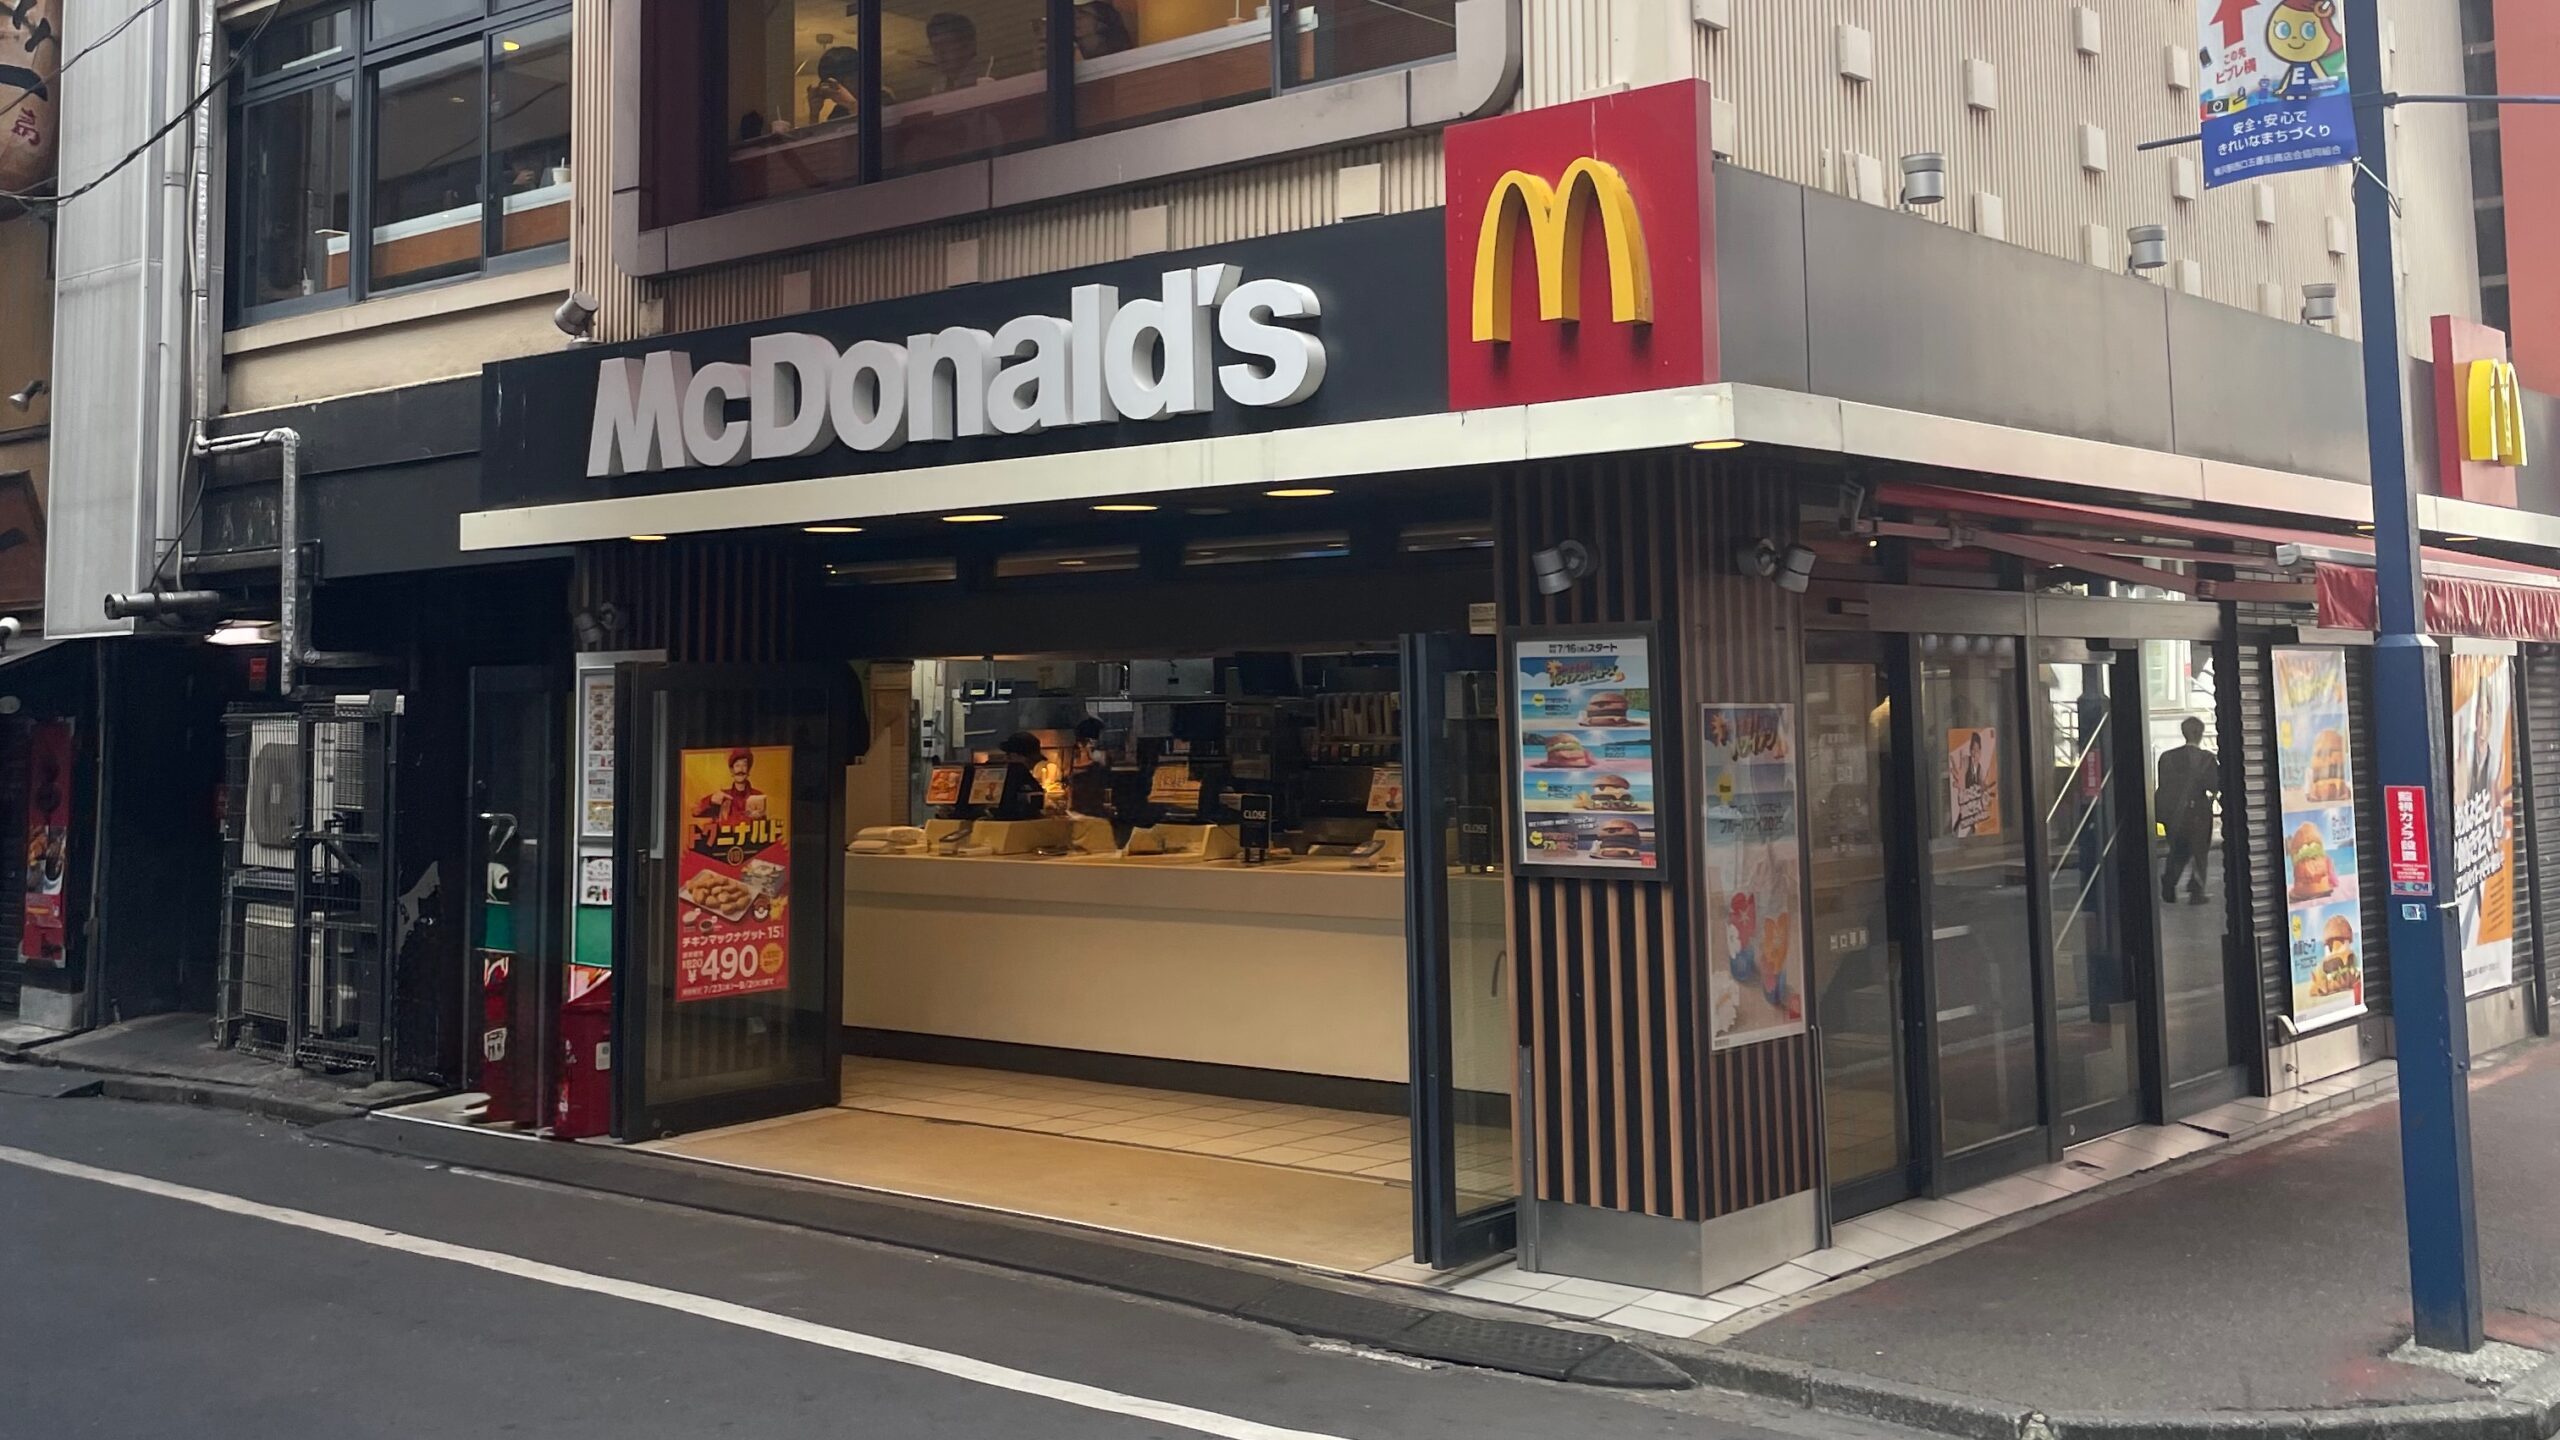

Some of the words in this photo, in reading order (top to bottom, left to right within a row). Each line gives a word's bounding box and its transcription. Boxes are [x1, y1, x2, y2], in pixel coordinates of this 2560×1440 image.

[2224, 47, 2247, 65] この先
[2233, 110, 2308, 136] 安全・安心で
[2217, 124, 2331, 156] きれいなまちづくり
[586, 263, 1327, 478] McDonald's
[1243, 810, 1267, 820] CLOSE
[682, 929, 766, 948] チキンマックナゲット
